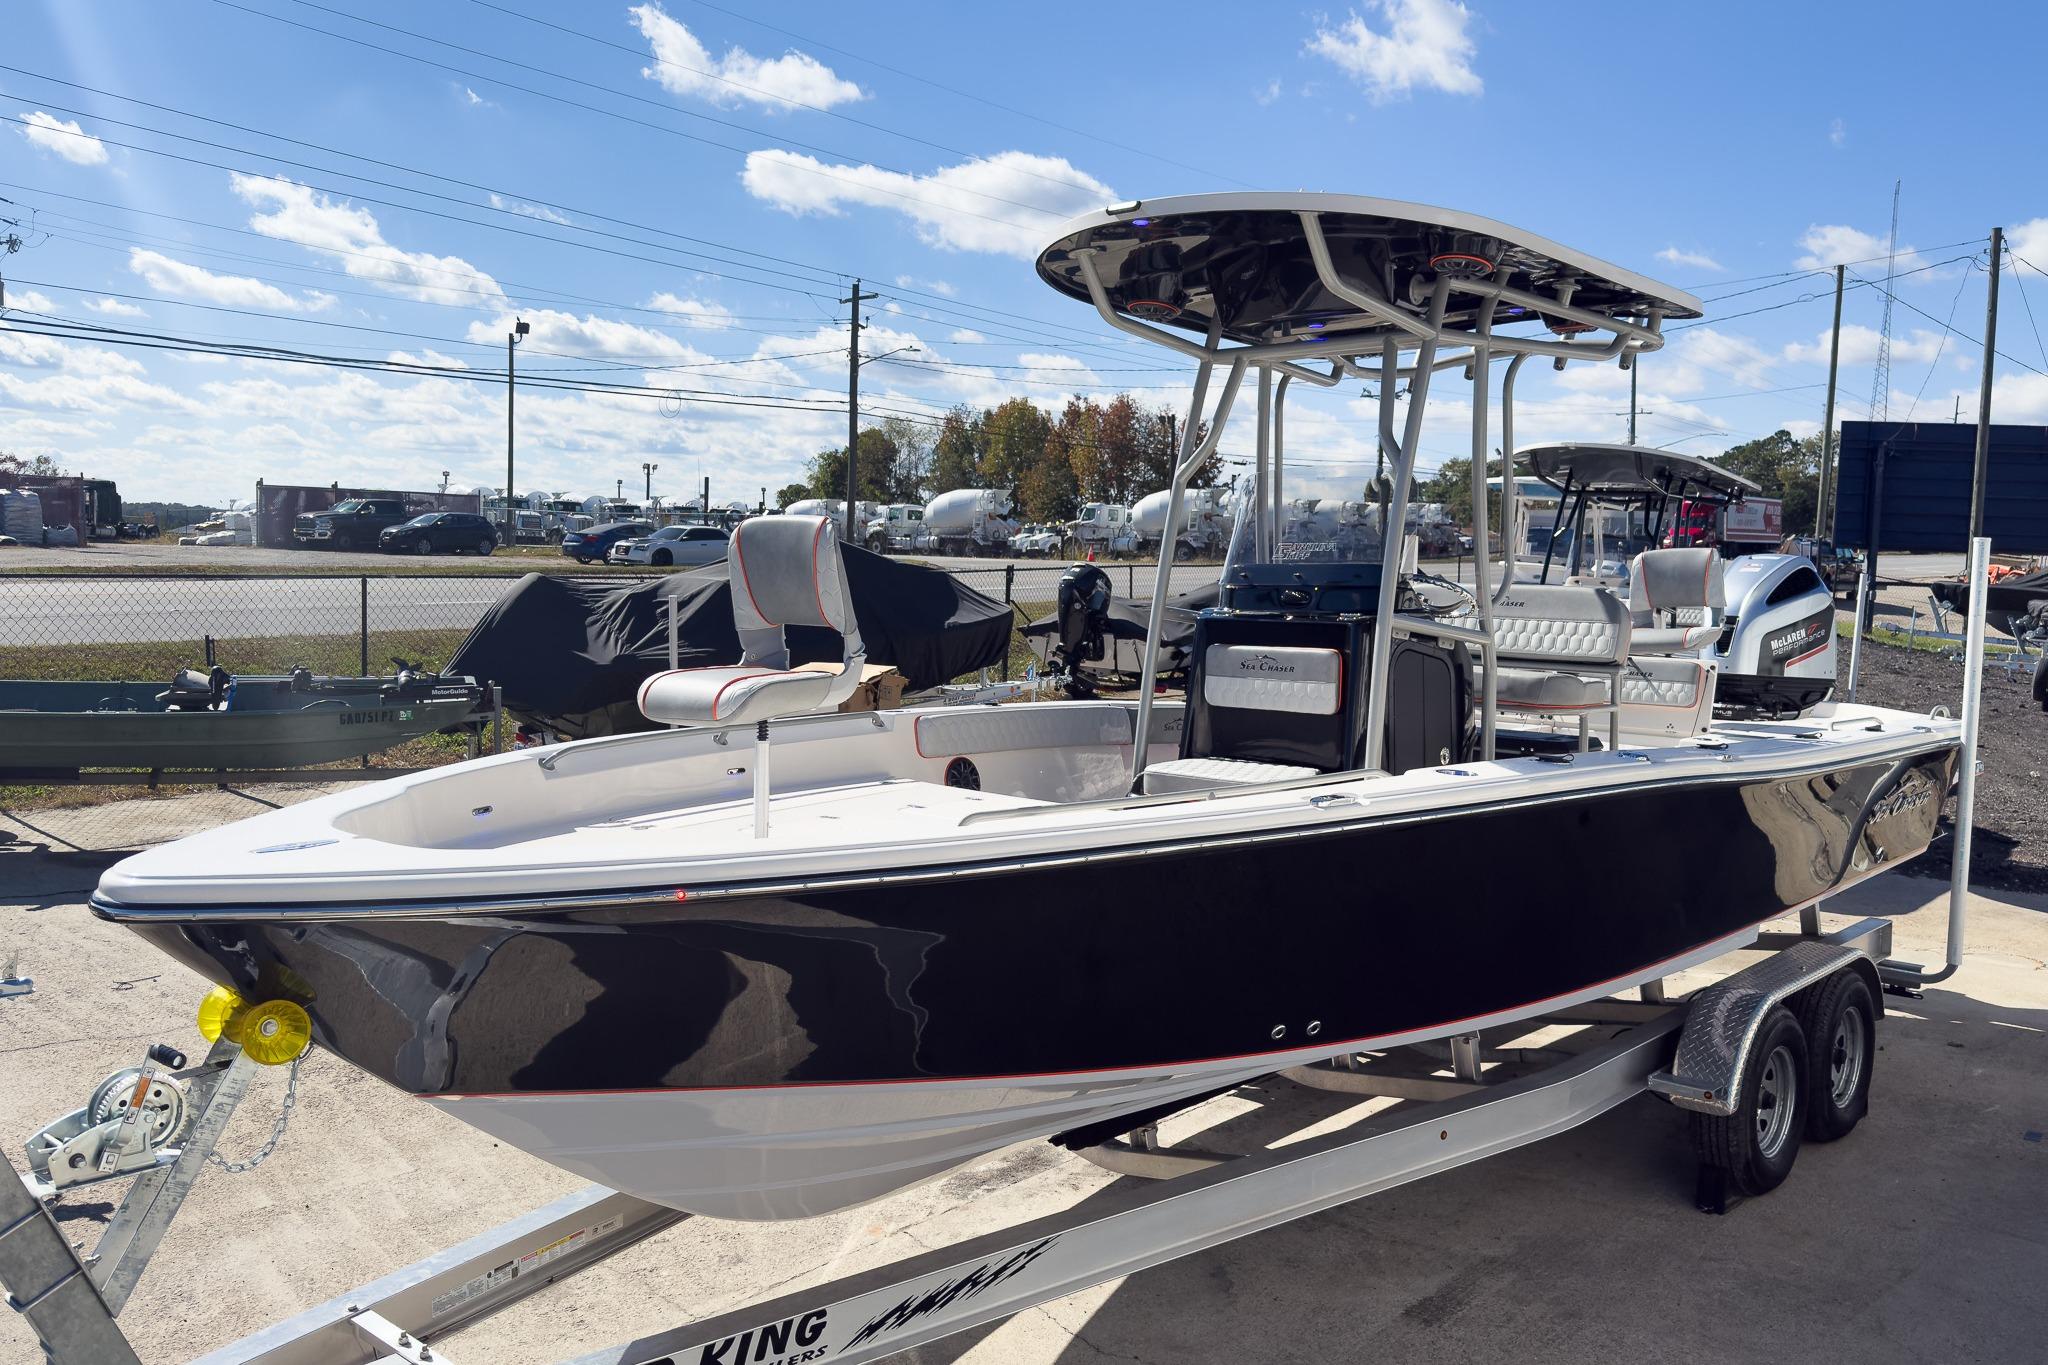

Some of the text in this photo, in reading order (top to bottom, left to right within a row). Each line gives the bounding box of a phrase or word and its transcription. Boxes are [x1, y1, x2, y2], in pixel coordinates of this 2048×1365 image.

[1770, 628, 1806, 651] McLAREN
[1259, 661, 1296, 673] CHASER
[700, 1308, 828, 1365] KING
